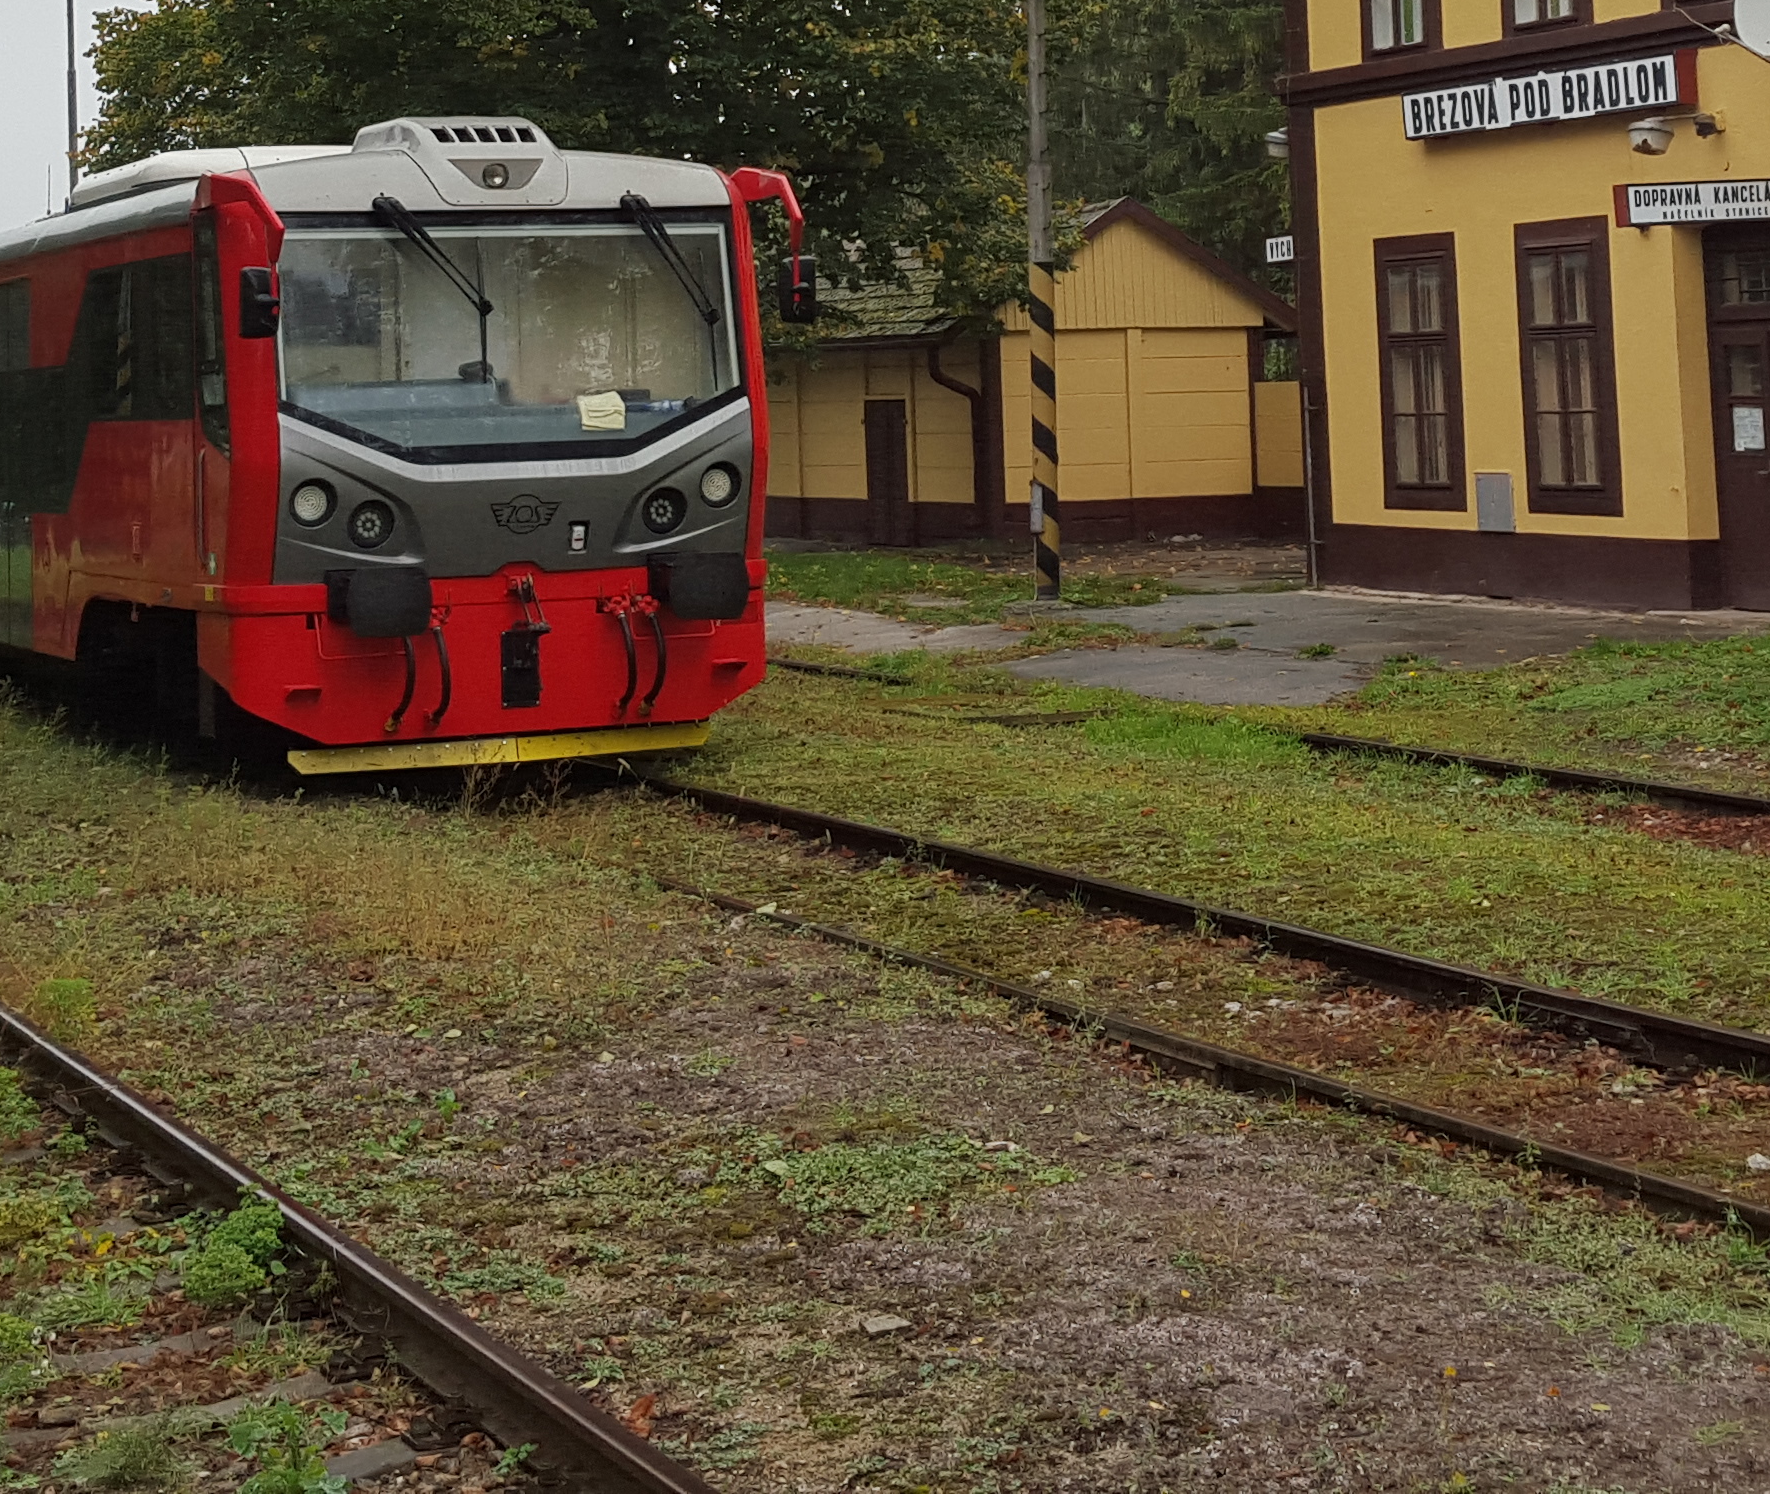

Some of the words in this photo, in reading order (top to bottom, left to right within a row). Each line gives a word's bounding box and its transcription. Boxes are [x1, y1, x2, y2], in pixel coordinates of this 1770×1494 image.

[1411, 82, 1499, 135] BREZOVÁ
[1509, 78, 1550, 121] POD
[1561, 60, 1668, 114] BRADLOM
[1634, 184, 1701, 207] DOPRAVNÁ
[1725, 206, 1769, 218] STANICE
